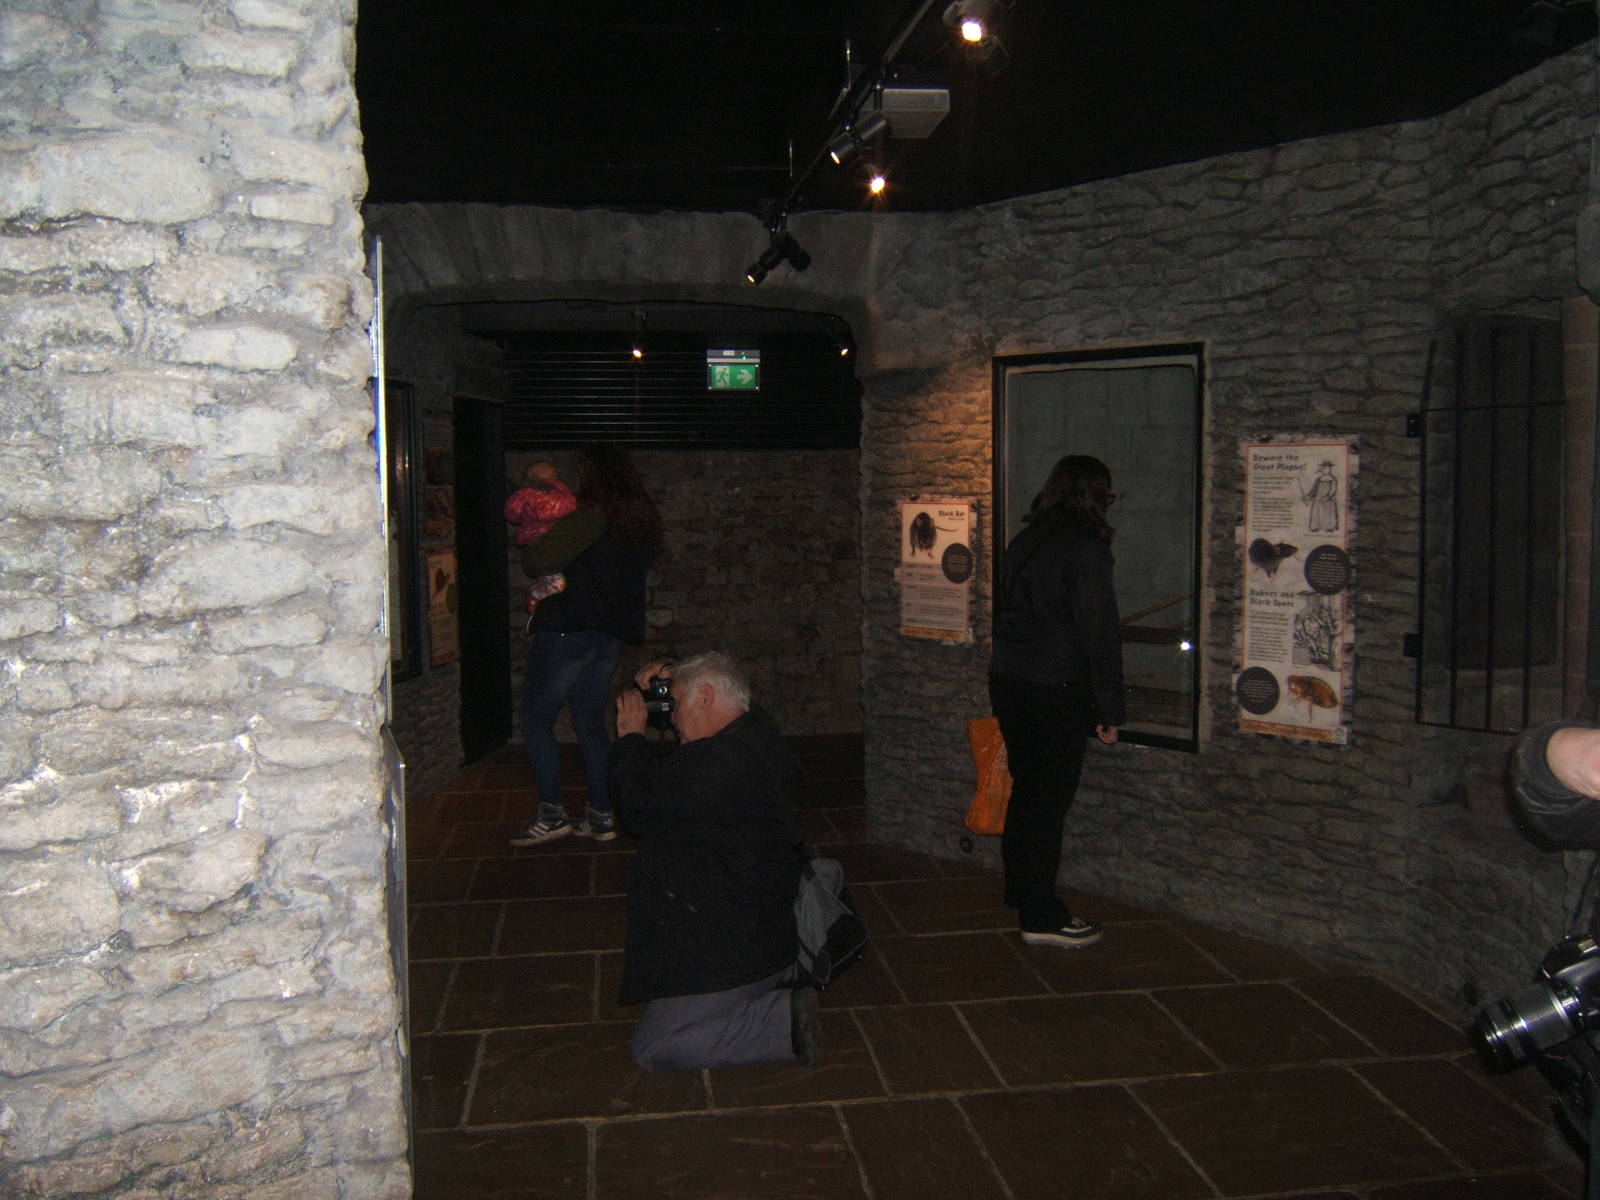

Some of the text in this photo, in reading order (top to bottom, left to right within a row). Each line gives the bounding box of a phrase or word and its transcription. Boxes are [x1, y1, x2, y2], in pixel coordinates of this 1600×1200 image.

[1253, 454, 1299, 462] Beware the
[1253, 463, 1275, 471] Great
[1280, 590, 1295, 598] and
[1250, 597, 1271, 606] Black
